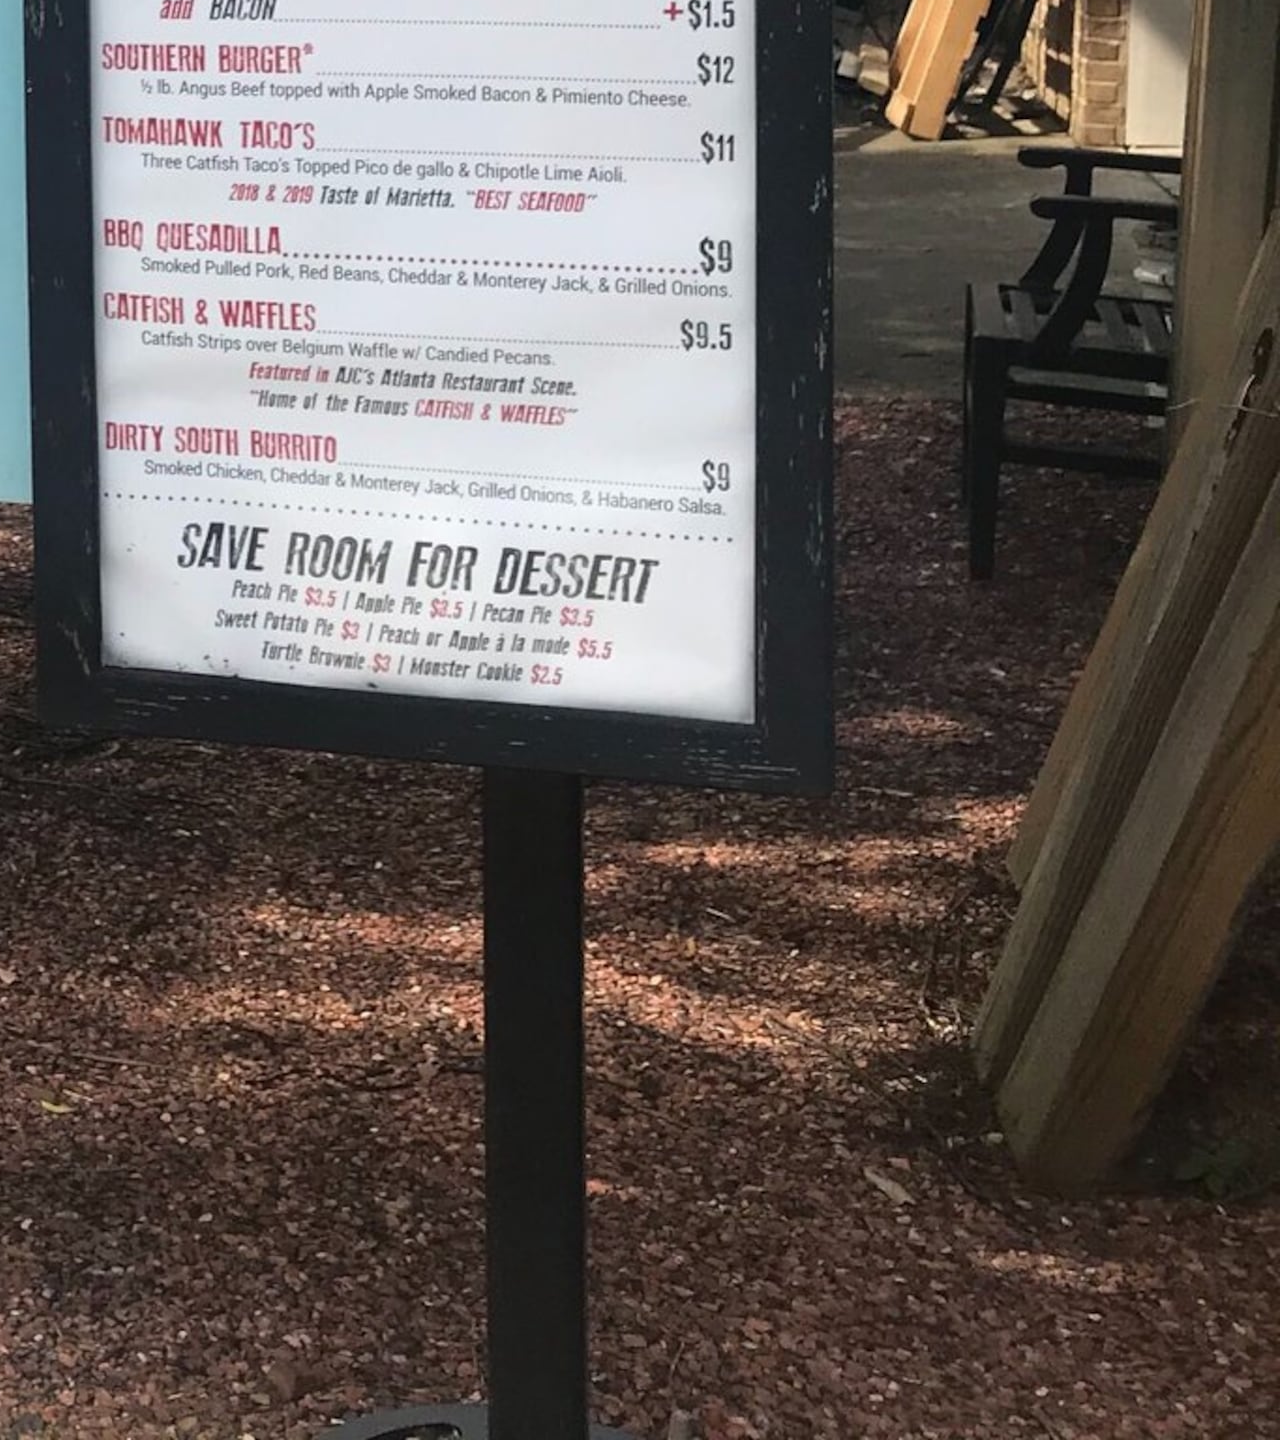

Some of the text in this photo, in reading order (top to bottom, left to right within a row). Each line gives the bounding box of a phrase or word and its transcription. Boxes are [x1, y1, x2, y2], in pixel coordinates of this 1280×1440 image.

[102, 116, 222, 147] TOMAHAWK
[701, 131, 734, 164] $11
[103, 219, 732, 276] BBQ QUESADILLA $9
[105, 293, 732, 351] CATFISH & WAFFLES $9.5
[178, 522, 659, 603] SAVE ROOM FOR DESSERT
